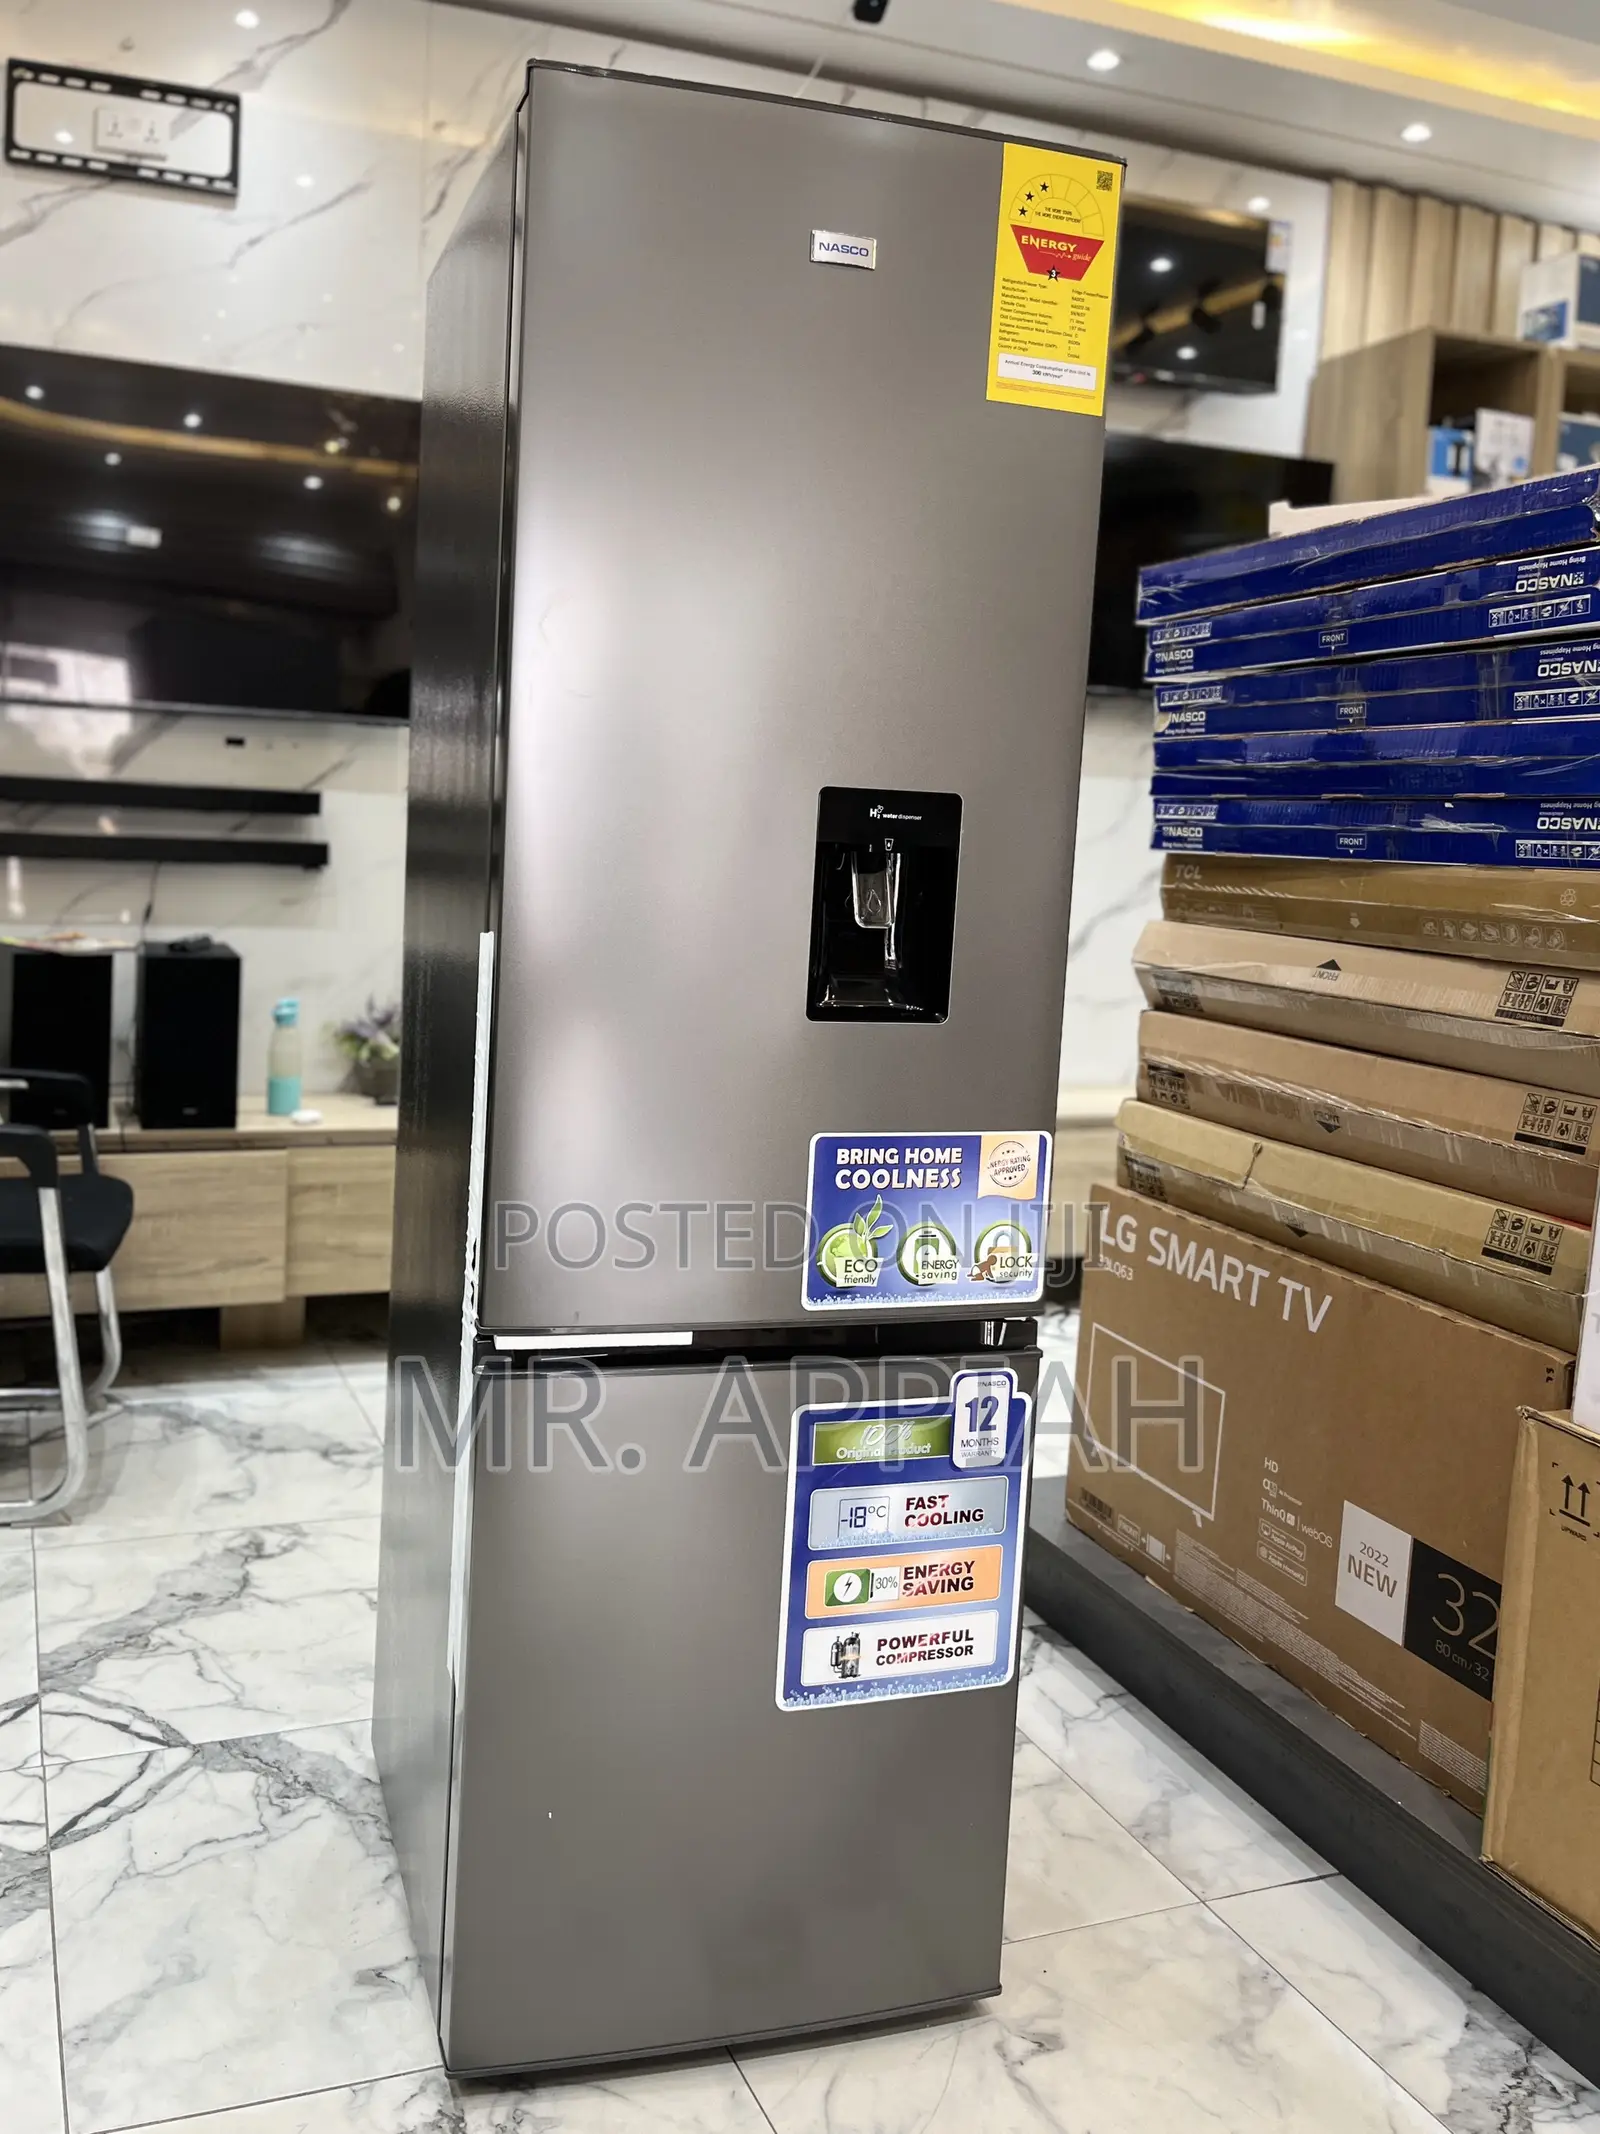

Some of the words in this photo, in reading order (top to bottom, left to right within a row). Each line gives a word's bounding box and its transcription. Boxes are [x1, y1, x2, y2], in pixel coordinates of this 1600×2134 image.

[819, 242, 869, 257] NASCO
[1021, 235, 1077, 252] ENERGY
[1072, 253, 1091, 261] guide
[1052, 269, 1056, 278] 3
[1550, 559, 1568, 567] Home
[1516, 573, 1573, 593] NASCO
[1322, 633, 1345, 643] FRONT
[1162, 649, 1193, 662] NASCO
[1537, 660, 1597, 677] NASCO
[1172, 711, 1206, 723] NASCO
[1339, 706, 1363, 714] FRONT
[1537, 817, 1598, 830] NASCO
[1169, 827, 1203, 837] NASCO
[1175, 865, 1202, 880] TCL
[836, 1148, 899, 1165] BRING
[904, 1147, 963, 1164] HOME
[987, 1159, 1009, 1169] NERGY
[994, 1164, 1026, 1176] APPROVED
[835, 1168, 962, 1190] COOLNESS
[844, 1259, 878, 1273] ECO
[922, 1260, 959, 1270] ENERGY
[1000, 1255, 1032, 1268] LOCK
[922, 1270, 957, 1280] saving
[1000, 1268, 1032, 1278] security
[1100, 1206, 1138, 1253] LG
[1146, 1226, 1271, 1307] SMART
[1277, 1276, 1333, 1333] TV
[844, 1275, 876, 1287] friendly
[965, 1396, 999, 1432] 12
[961, 1437, 999, 1448] MONTHS
[836, 1445, 885, 1461] Original
[961, 1450, 997, 1458] WARRANTY
[1264, 1457, 1278, 1473] HD
[905, 1494, 950, 1511] FAST
[904, 1509, 984, 1528] COOLING
[1261, 1497, 1286, 1523] ThinQ
[1302, 1524, 1333, 1548] webOS
[1359, 1542, 1389, 1568] 2022
[903, 1560, 976, 1581] ENERGY
[1347, 1554, 1398, 1599] NEW
[876, 1575, 898, 1590] 30%
[902, 1576, 975, 1598] SAVING
[1432, 1573, 1500, 1660] 32
[876, 1628, 974, 1651] POWERFUL
[876, 1645, 974, 1666] COMPRESSOR
[1435, 1639, 1451, 1658] 80
[1452, 1652, 1468, 1669] cm
[1474, 1663, 1490, 1682] 32
